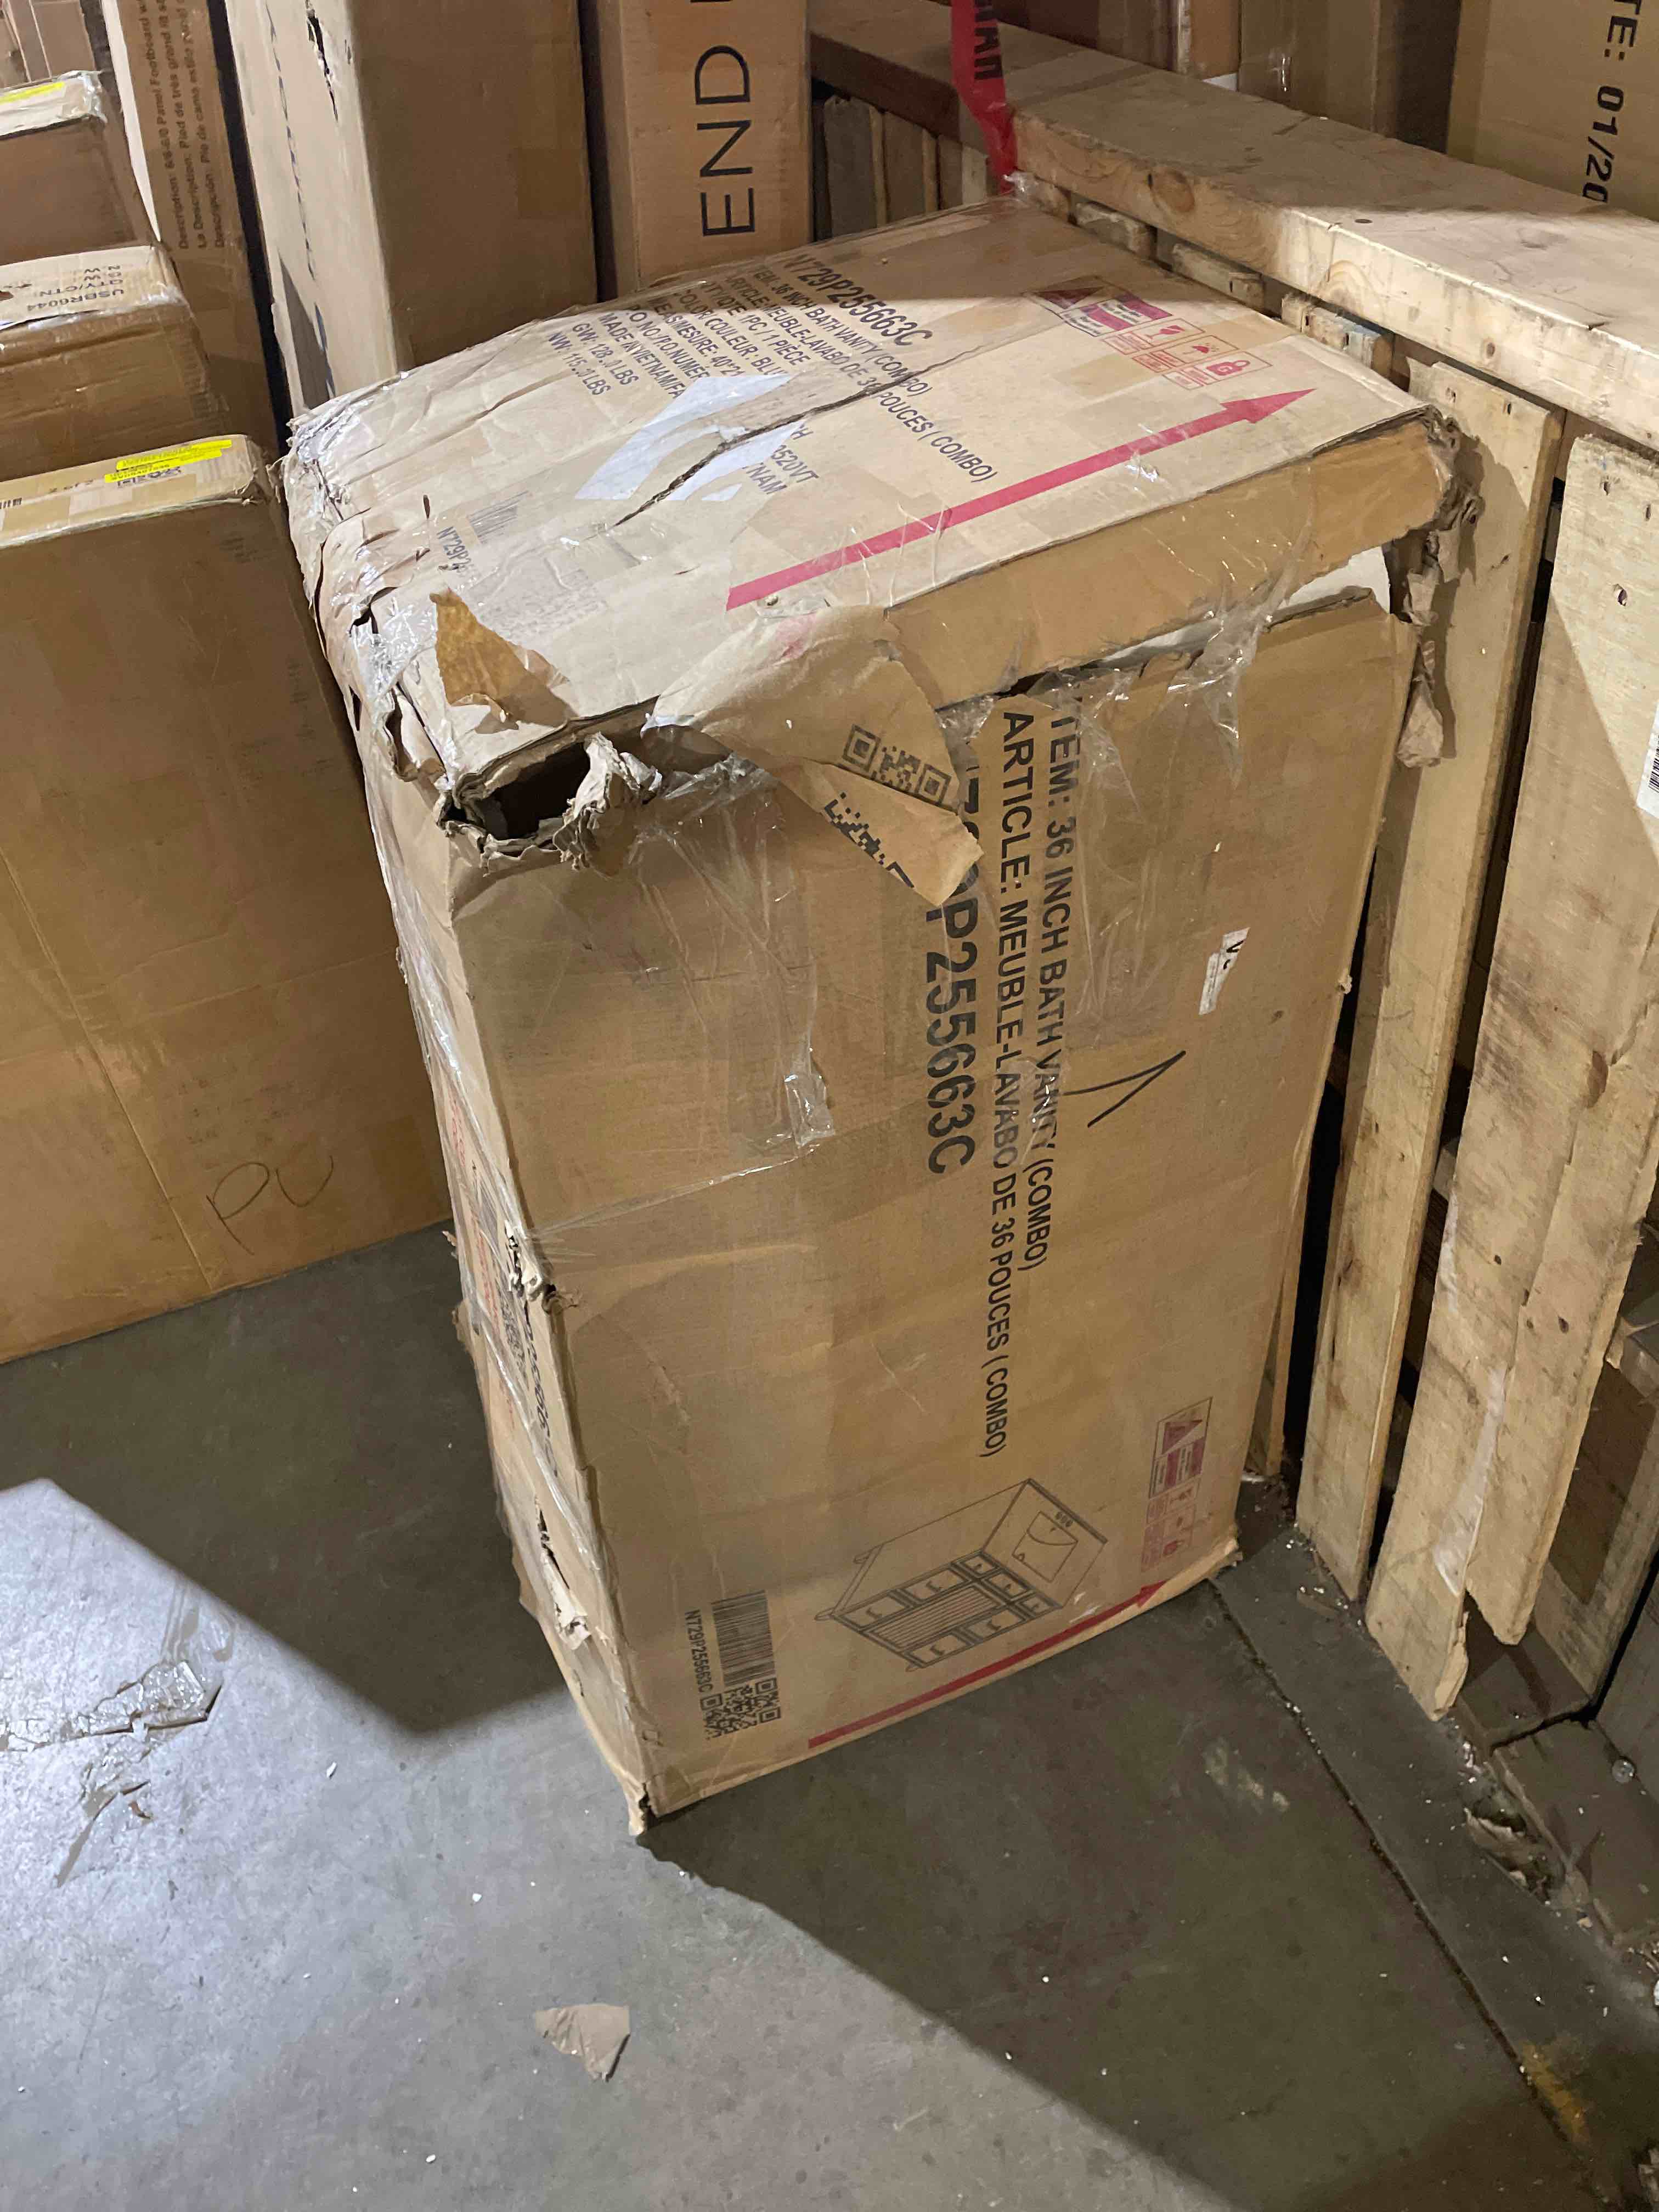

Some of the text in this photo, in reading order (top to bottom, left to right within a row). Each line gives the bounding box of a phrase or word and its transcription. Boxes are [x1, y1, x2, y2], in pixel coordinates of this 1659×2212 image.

[139, 18, 160, 86] Footboard
[695, 45, 755, 236] END
[27, 288, 125, 312] USBR6044
[599, 312, 634, 343] MADE
[768, 338, 811, 366] PIÈCE
[805, 307, 845, 332] BATH
[833, 326, 884, 355] VANITY
[582, 374, 612, 396] LBS
[610, 364, 640, 385] LBS
[840, 362, 870, 379] DE
[1000, 712, 1035, 894] ARTICLE:
[1045, 816, 1076, 859] 36
[1041, 866, 1074, 954] INCH
[926, 766, 979, 1173] P255663C
[1036, 958, 1068, 1047] BATH
[993, 899, 1028, 1169] MEUBLE-LAVABO
[1031, 1048, 1062, 1150] VANITY
[991, 1173, 1017, 1216] DE
[1017, 1159, 1054, 1271] (COMBO)
[991, 1217, 1015, 1249] 36
[986, 1250, 1013, 1351] POUCES
